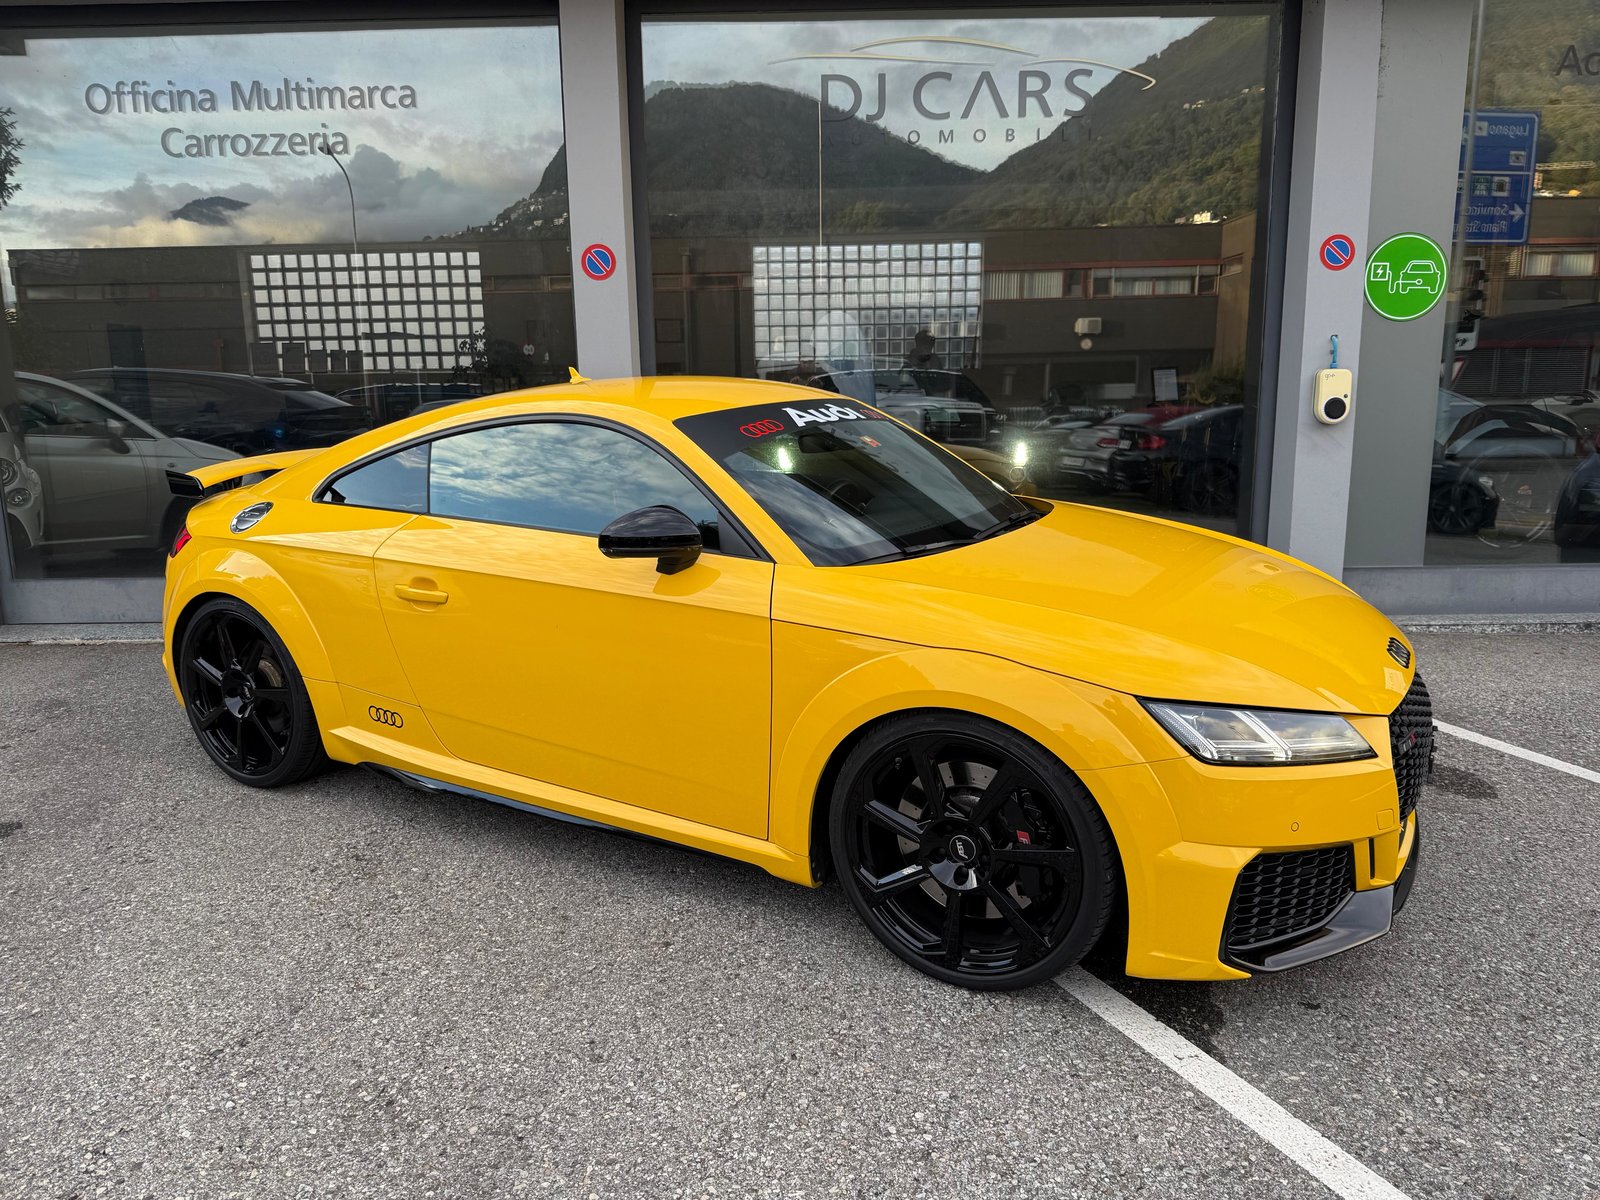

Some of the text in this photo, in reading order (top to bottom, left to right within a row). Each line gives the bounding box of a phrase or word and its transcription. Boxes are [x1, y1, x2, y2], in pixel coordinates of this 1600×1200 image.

[84, 77, 418, 115] Officina Multimarca
[820, 68, 1095, 123] DJ CARS
[161, 123, 350, 159] Carrozzeria
[781, 403, 867, 427] Audi
